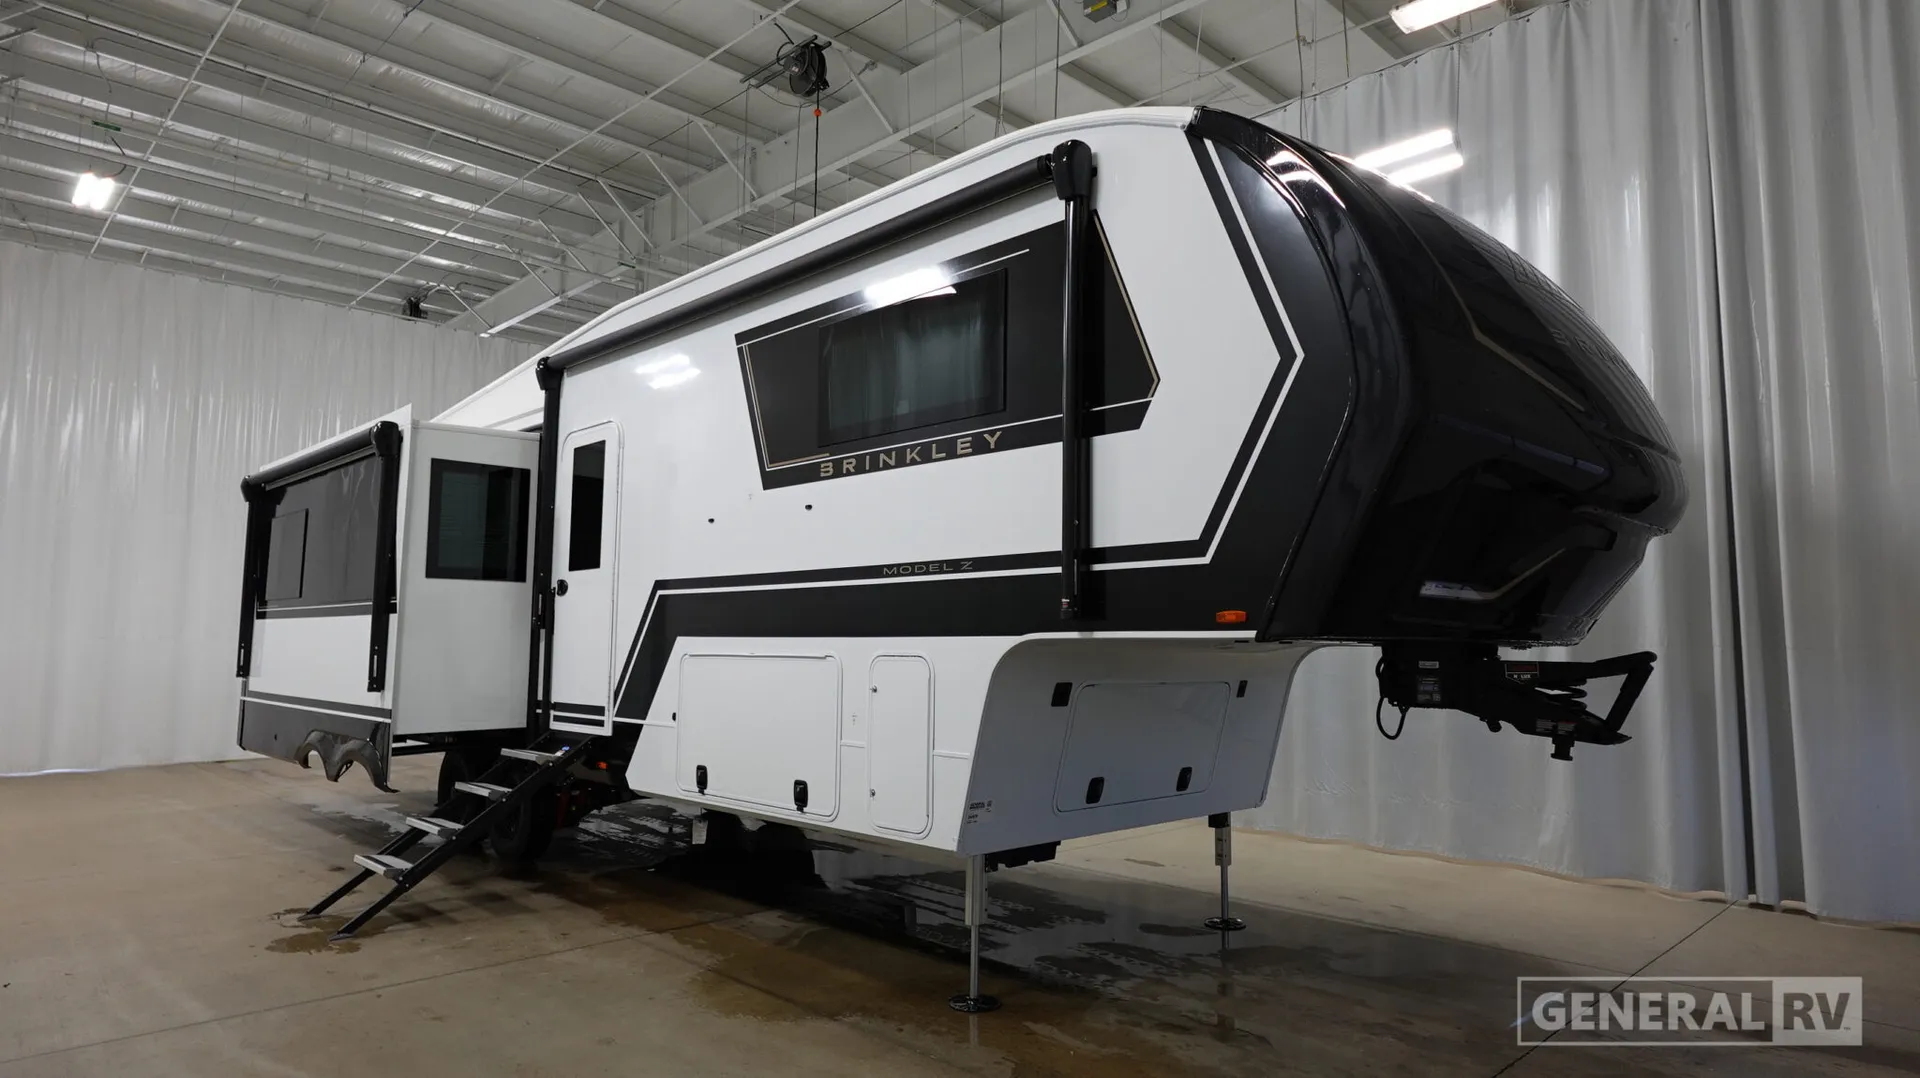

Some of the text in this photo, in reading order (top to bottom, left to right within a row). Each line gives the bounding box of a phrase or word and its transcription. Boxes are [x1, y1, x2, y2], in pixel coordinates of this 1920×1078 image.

[820, 431, 1002, 478] BRINKLEY
[883, 560, 973, 576] MODEL Z
